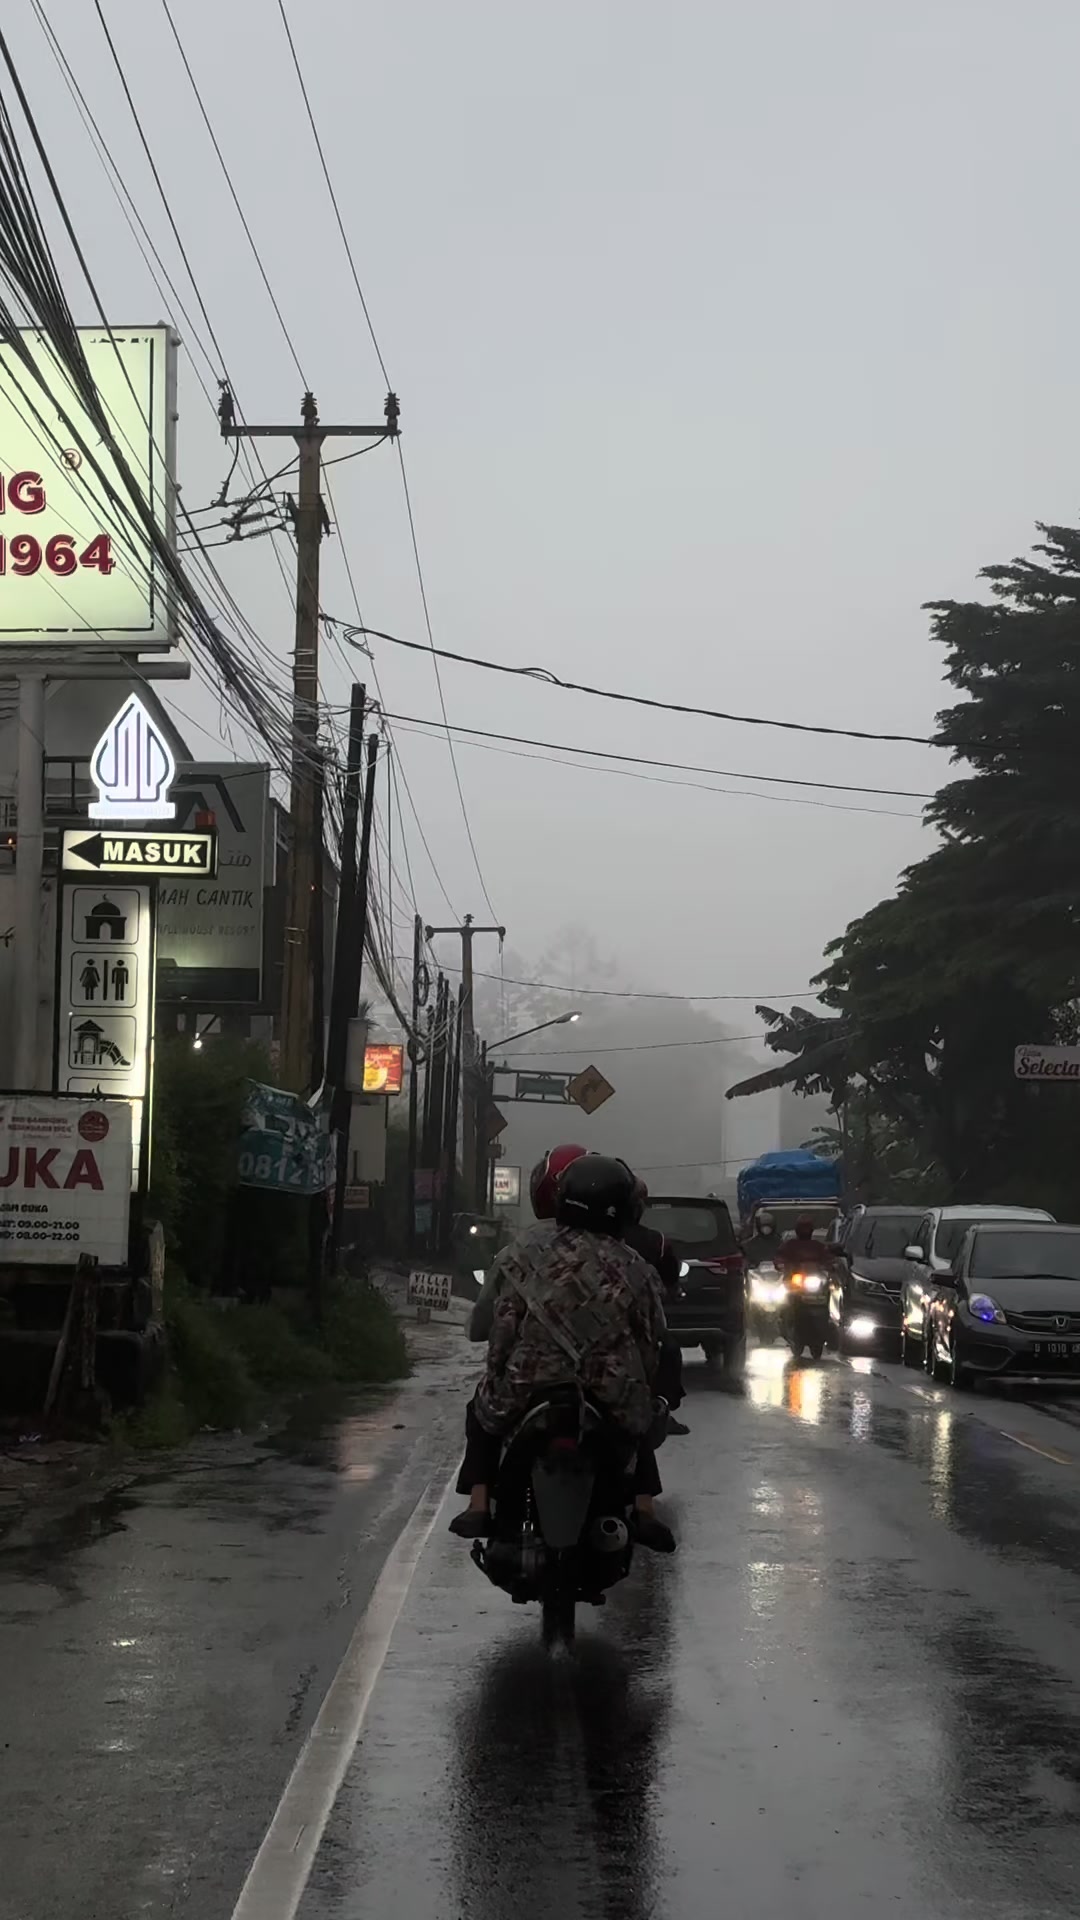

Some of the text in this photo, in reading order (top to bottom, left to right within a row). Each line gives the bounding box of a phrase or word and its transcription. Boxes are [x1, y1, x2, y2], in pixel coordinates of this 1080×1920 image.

[0, 470, 46, 515] G
[103, 841, 203, 864] MASUK
[196, 888, 254, 909] CANTIK
[1017, 1057, 1080, 1077] Selecta
[415, 1274, 449, 1288] VILLA
